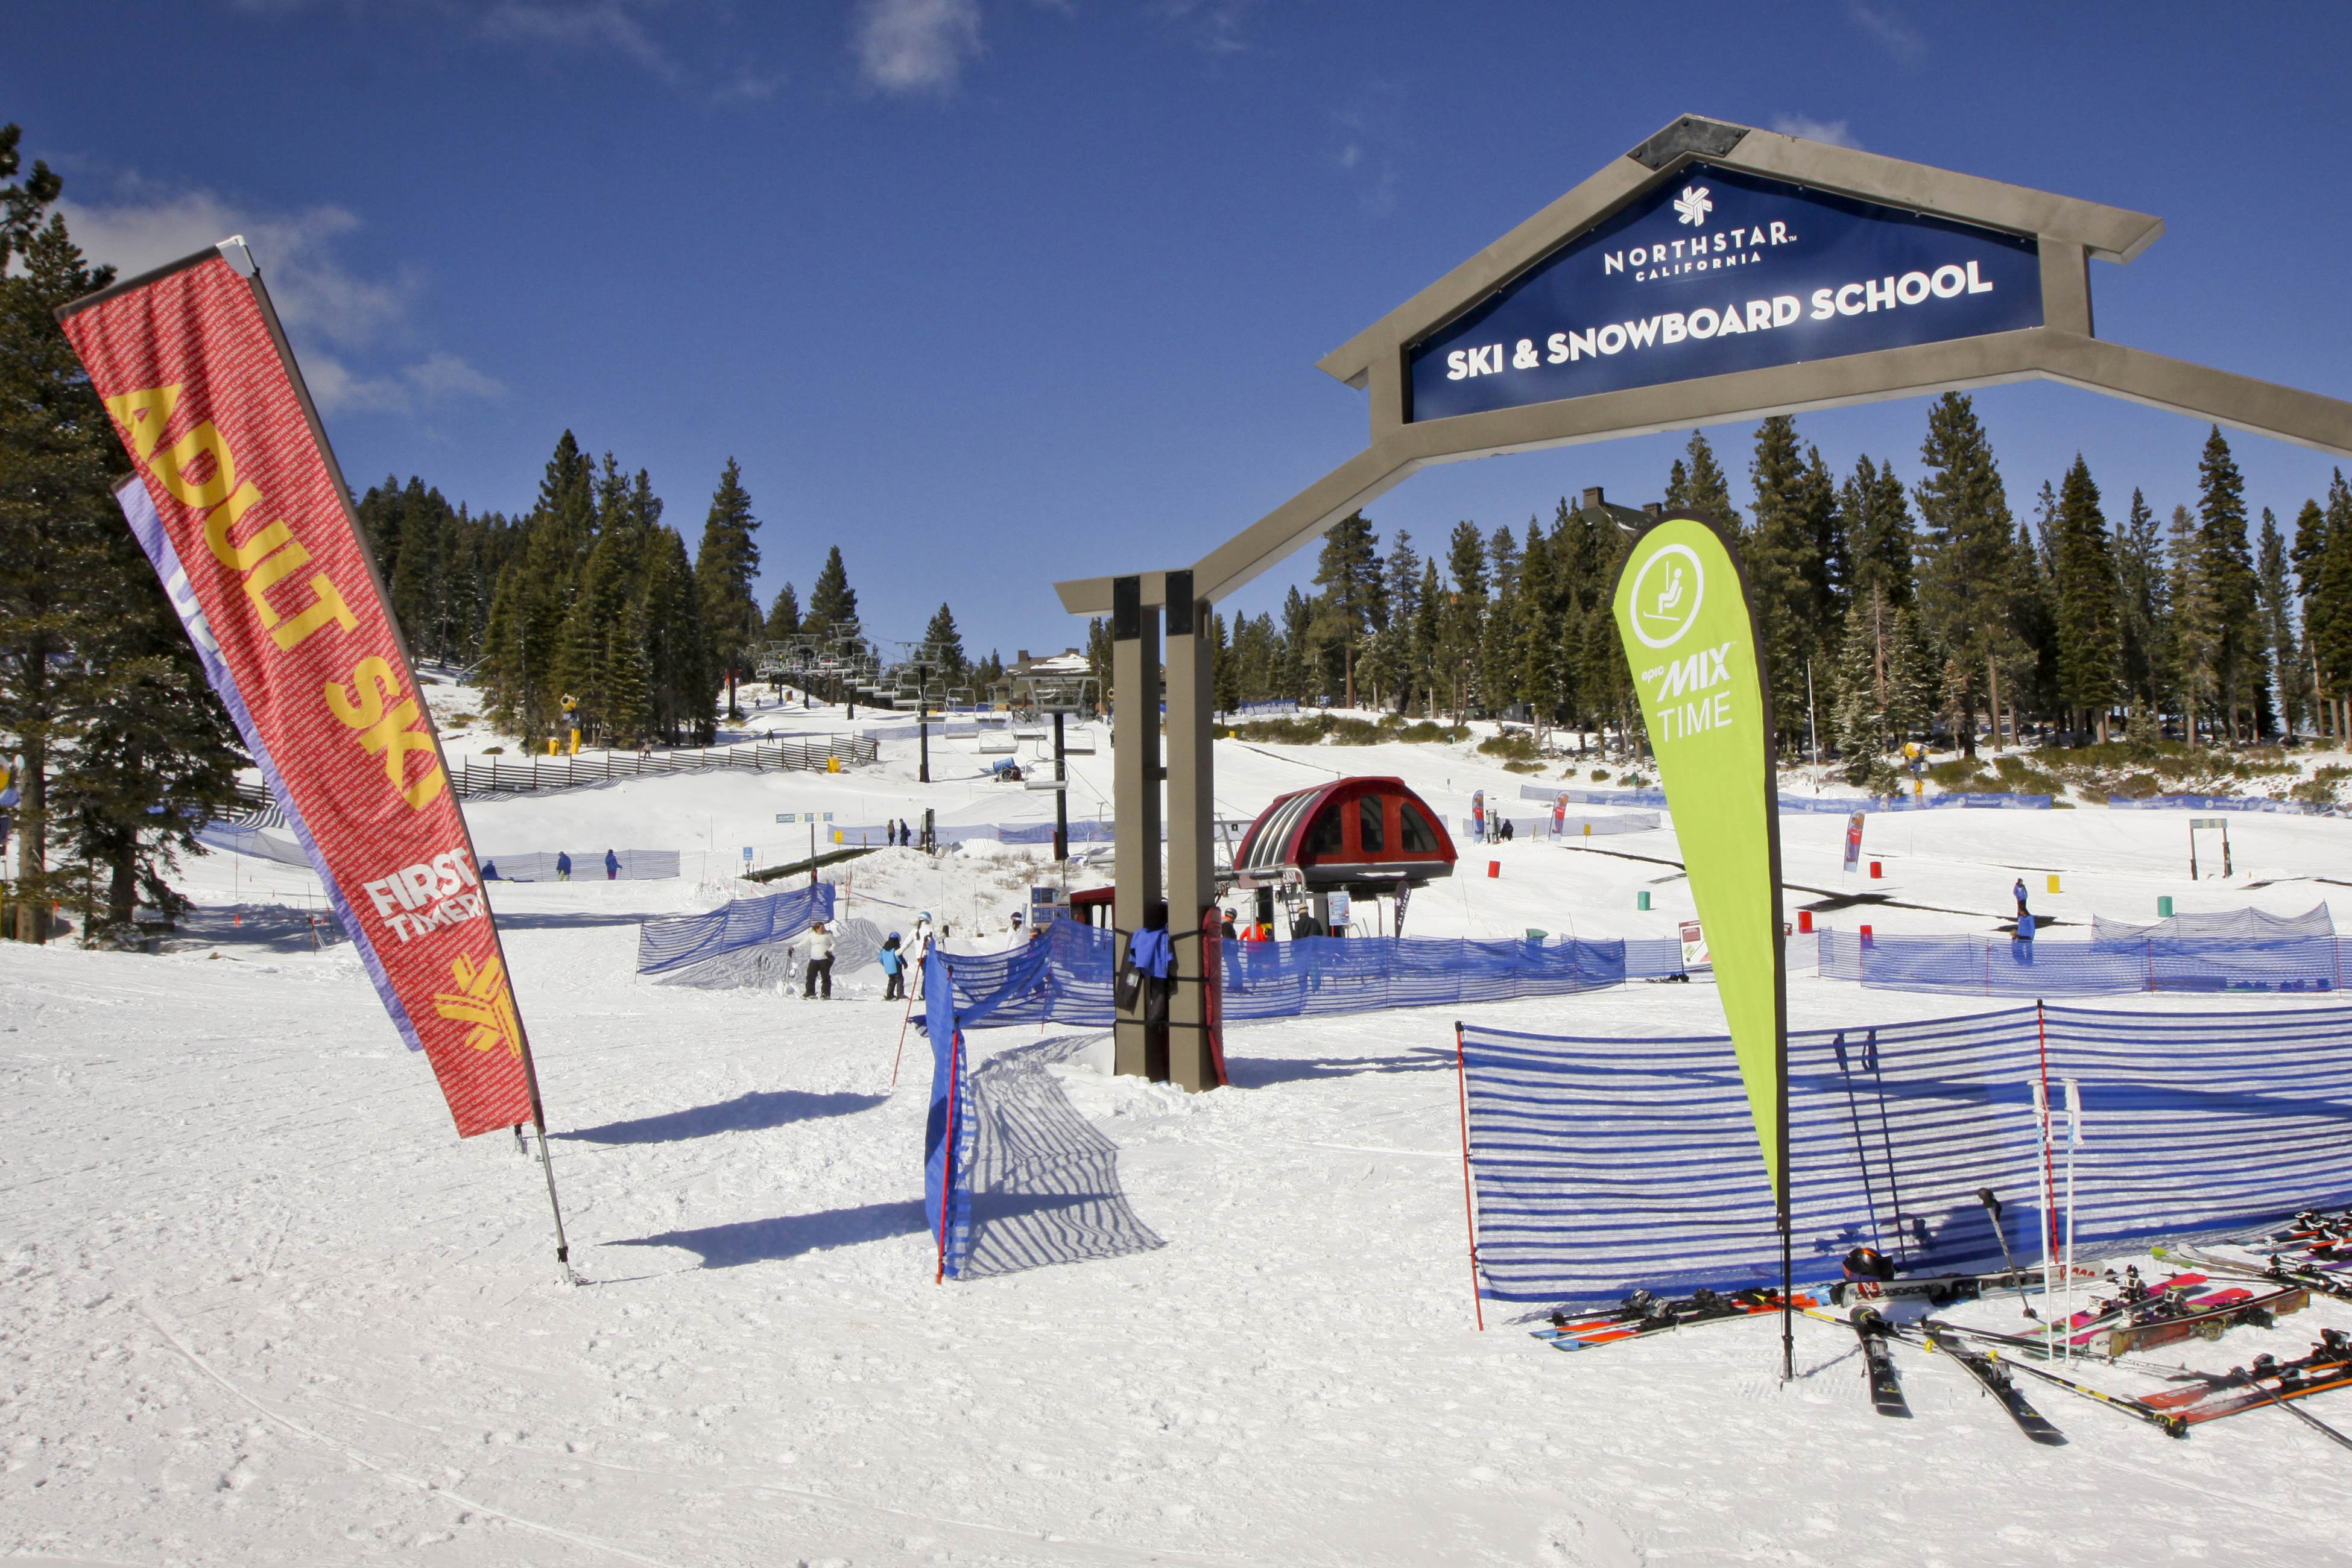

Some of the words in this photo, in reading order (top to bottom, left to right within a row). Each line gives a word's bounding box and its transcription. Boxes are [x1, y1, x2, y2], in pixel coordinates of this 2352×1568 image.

[1604, 221, 1788, 275] NORTHSTAR
[1636, 251, 1760, 282] CALIFORNIA
[1446, 344, 1502, 381] SKI
[1512, 338, 1539, 369] &
[1547, 296, 1801, 364] SNOWBOARD
[1810, 261, 1993, 320] SCHOOL
[105, 382, 358, 651] ADULT
[324, 656, 446, 811] SKI
[1657, 691, 1732, 742] TIME
[362, 847, 477, 917] FIRST
